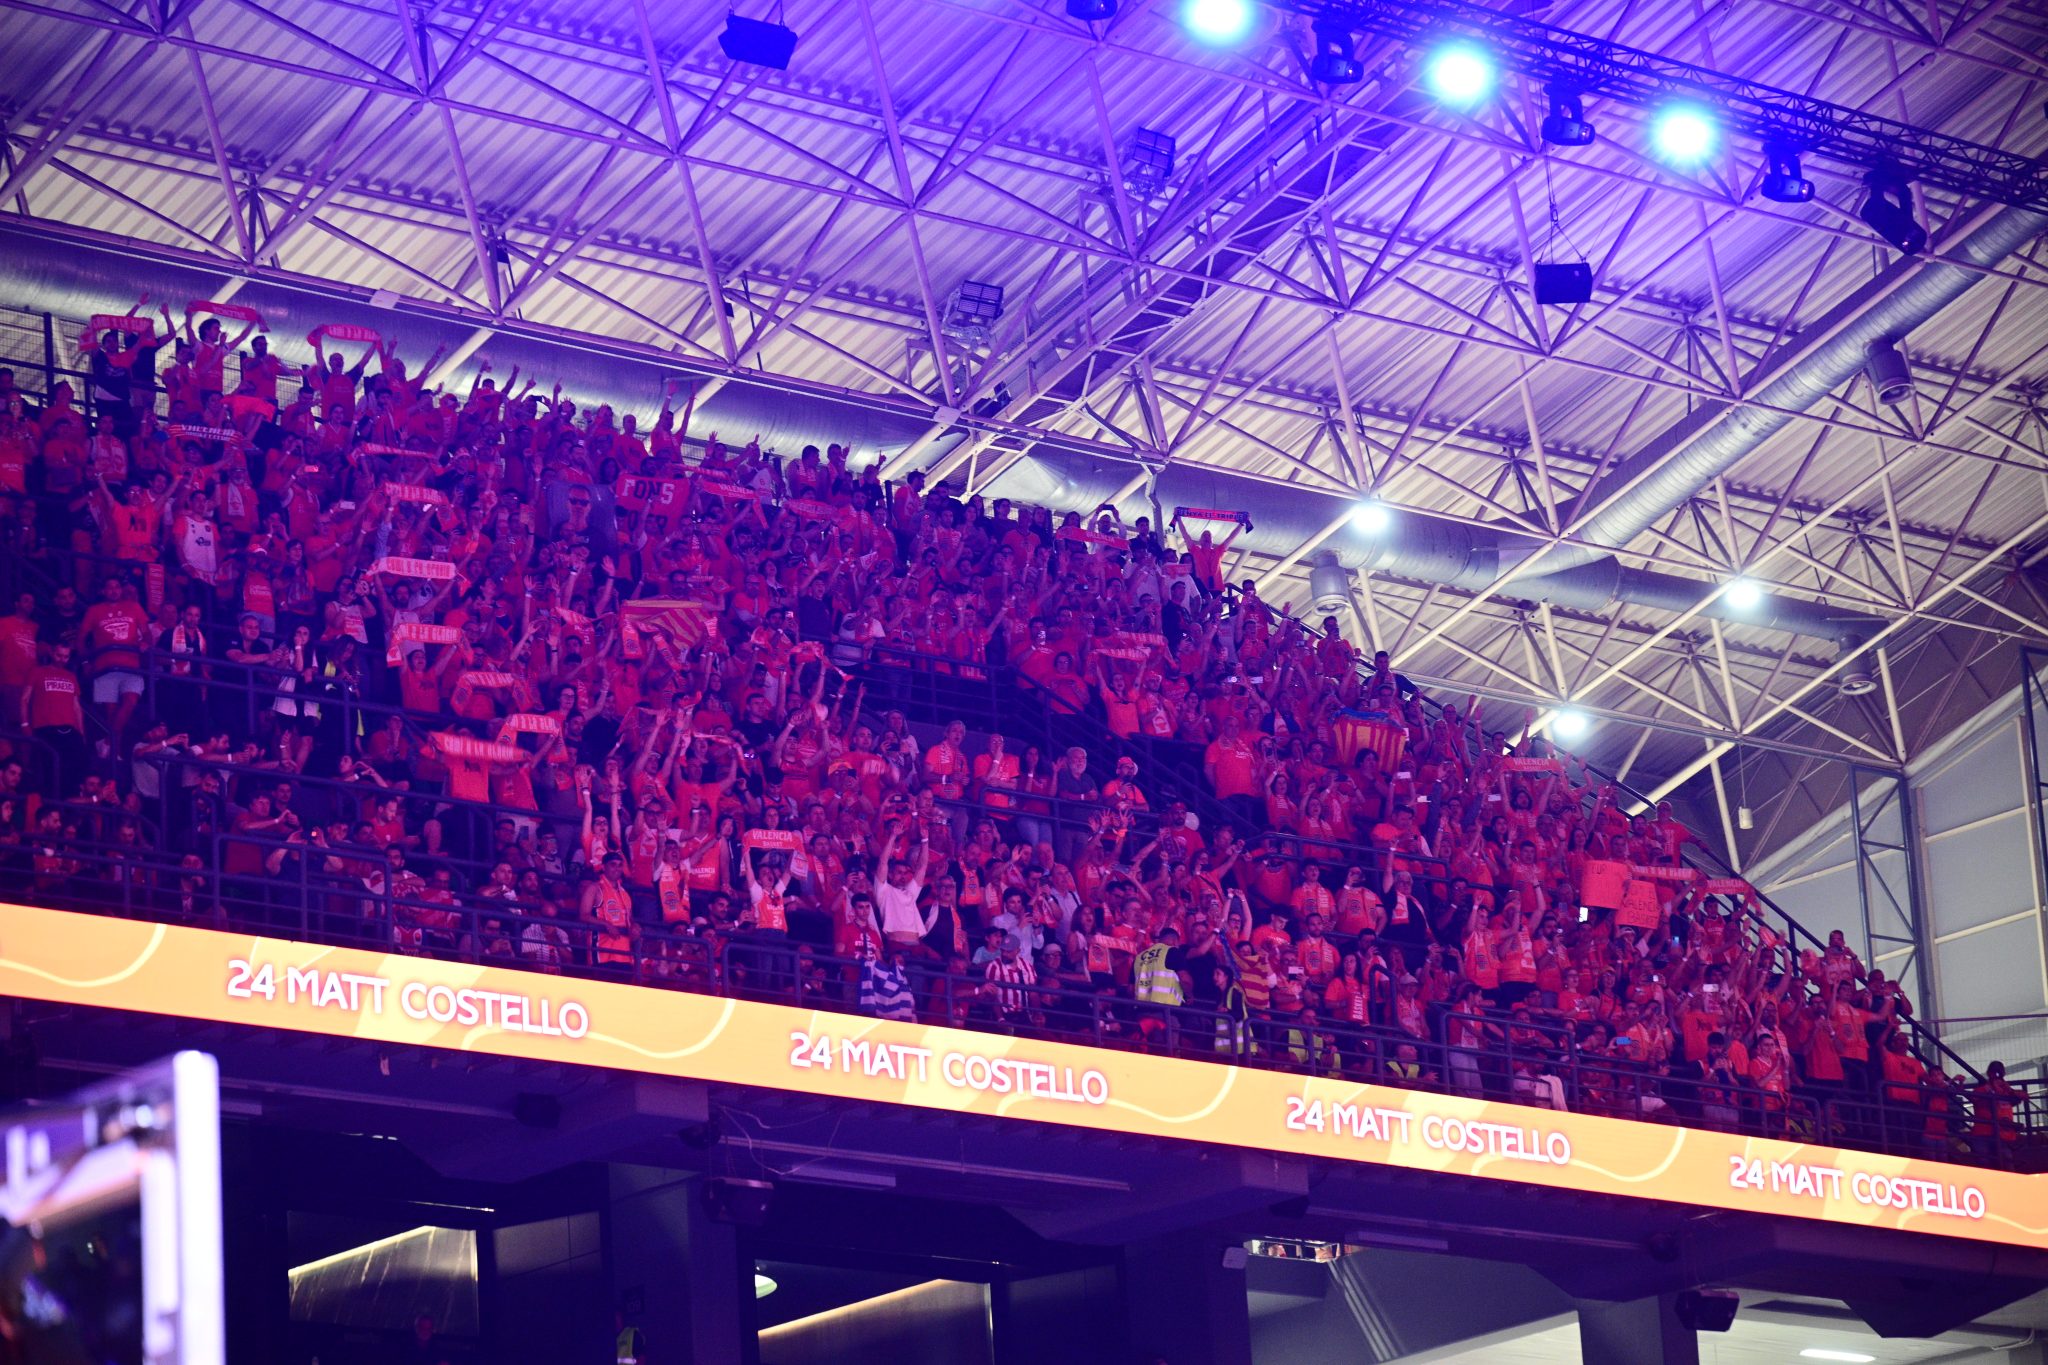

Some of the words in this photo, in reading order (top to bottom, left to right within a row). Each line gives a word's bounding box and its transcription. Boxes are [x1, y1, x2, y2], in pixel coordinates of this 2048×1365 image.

[753, 830, 793, 842] VALENCIA
[227, 959, 276, 1001] 24
[287, 966, 391, 1014] MATT
[401, 982, 590, 1039] COSTELLO
[789, 1031, 833, 1070] 24
[841, 1038, 934, 1082] MATT
[942, 1052, 1108, 1105] COSTELLO
[1286, 1096, 1325, 1133] 24
[1329, 1102, 1416, 1144] MATT
[1422, 1115, 1571, 1165] COSTELLO
[1729, 1156, 1765, 1190] 24
[1770, 1161, 1845, 1200] MATT
[1851, 1172, 1985, 1219] COSTELLO
